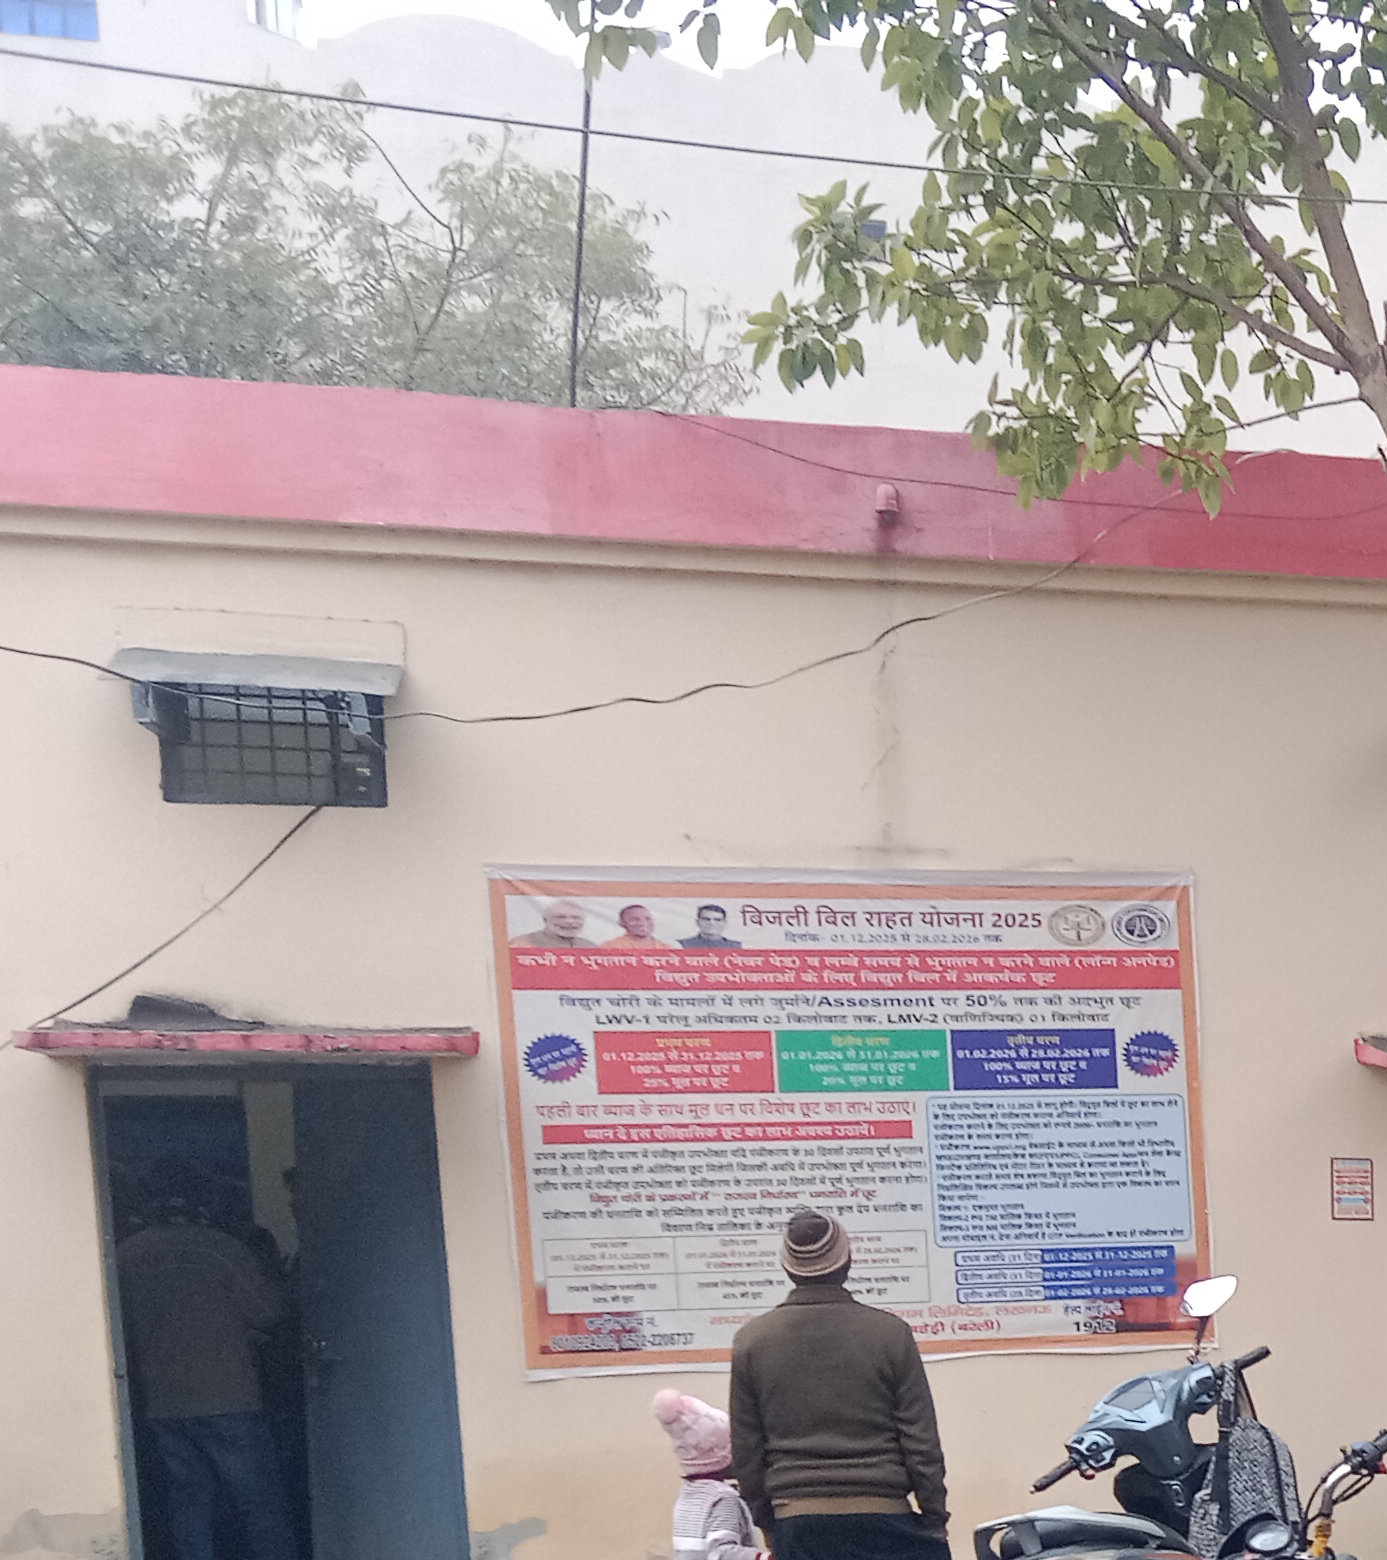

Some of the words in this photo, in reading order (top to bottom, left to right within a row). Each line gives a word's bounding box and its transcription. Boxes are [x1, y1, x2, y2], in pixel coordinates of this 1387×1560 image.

[740, 905, 809, 926] बिजली
[816, 905, 857, 927] बिल
[863, 912, 913, 928] राहत
[919, 906, 984, 927] योजना
[992, 913, 1042, 928] 2025
[580, 953, 639, 970] भुगतान
[926, 955, 978, 970] भुगतान
[559, 995, 601, 1011] विद्युत
[606, 994, 640, 1007] चोरी
[646, 994, 662, 1007] के
[667, 996, 715, 1007] मामलों
[721, 994, 733, 1006] में
[941, 998, 959, 1006] पर
[966, 995, 1007, 1007] 50%
[1013, 997, 1038, 1006] तक
[1043, 994, 1062, 1005] की
[887, 1014, 938, 1023] LMV-2
[536, 1101, 571, 1119] पहली
[602, 1105, 635, 1116] ब्याज
[639, 1099, 656, 1116] के
[657, 1104, 684, 1116] साथ
[688, 1104, 709, 1119] मूल
[714, 1103, 734, 1116] धन
[738, 1103, 755, 1115] पर
[759, 1099, 795, 1114] विशेष
[799, 1103, 821, 1118] छूट
[824, 1102, 842, 1114] का
[846, 1102, 872, 1114] लाभ
